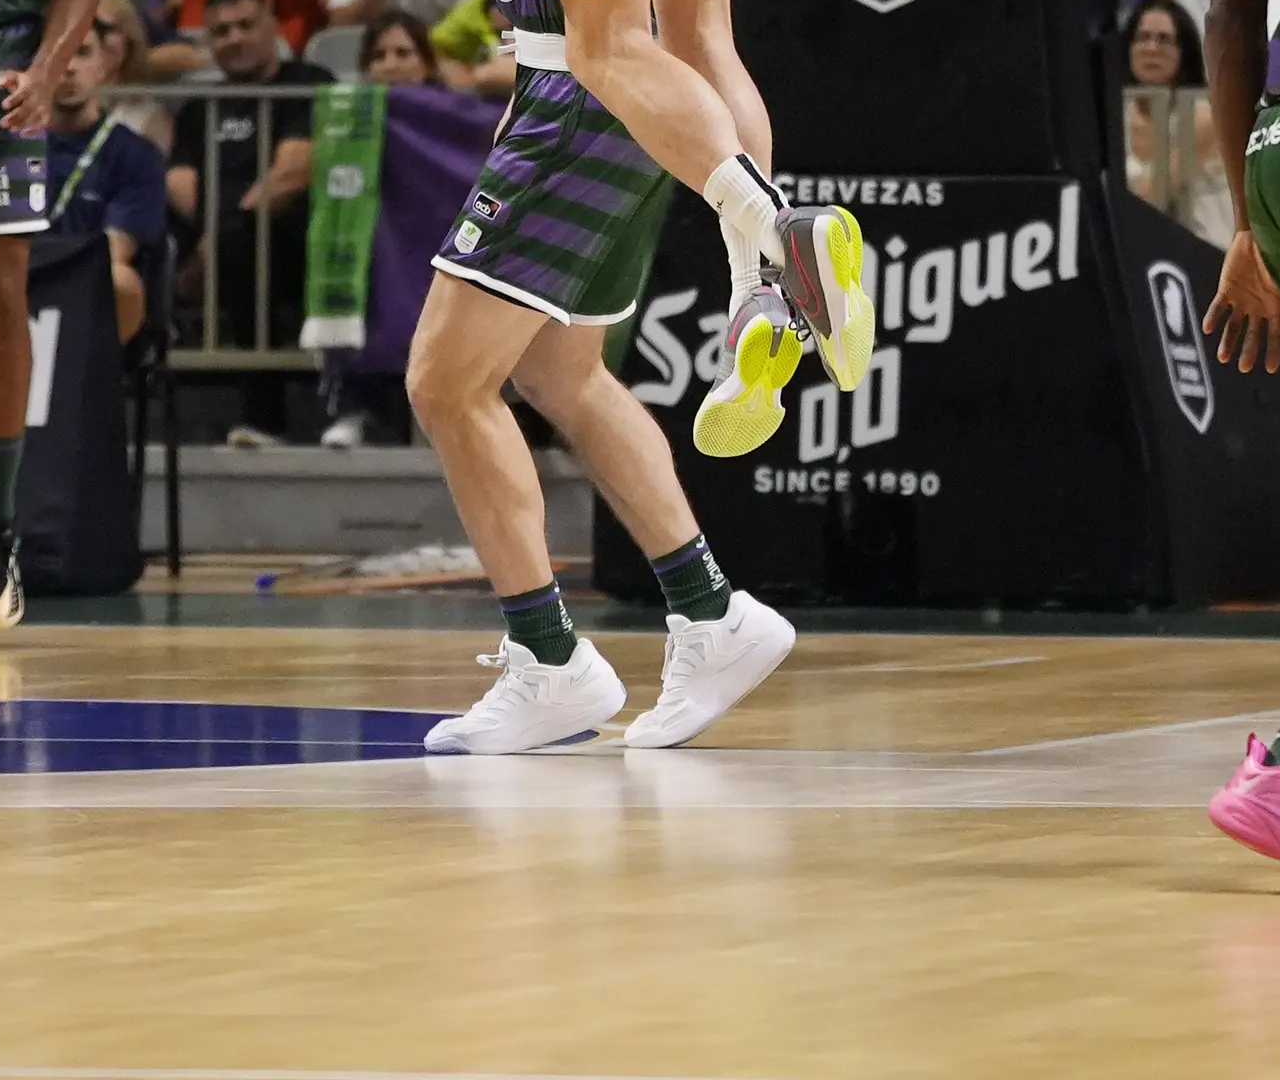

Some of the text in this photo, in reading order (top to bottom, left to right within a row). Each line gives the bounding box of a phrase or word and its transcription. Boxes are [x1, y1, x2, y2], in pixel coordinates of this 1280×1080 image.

[775, 174, 945, 207] CERVEZAS
[475, 200, 491, 215] acb
[863, 182, 1081, 343] iguel
[753, 466, 941, 498] SINCE 1890
